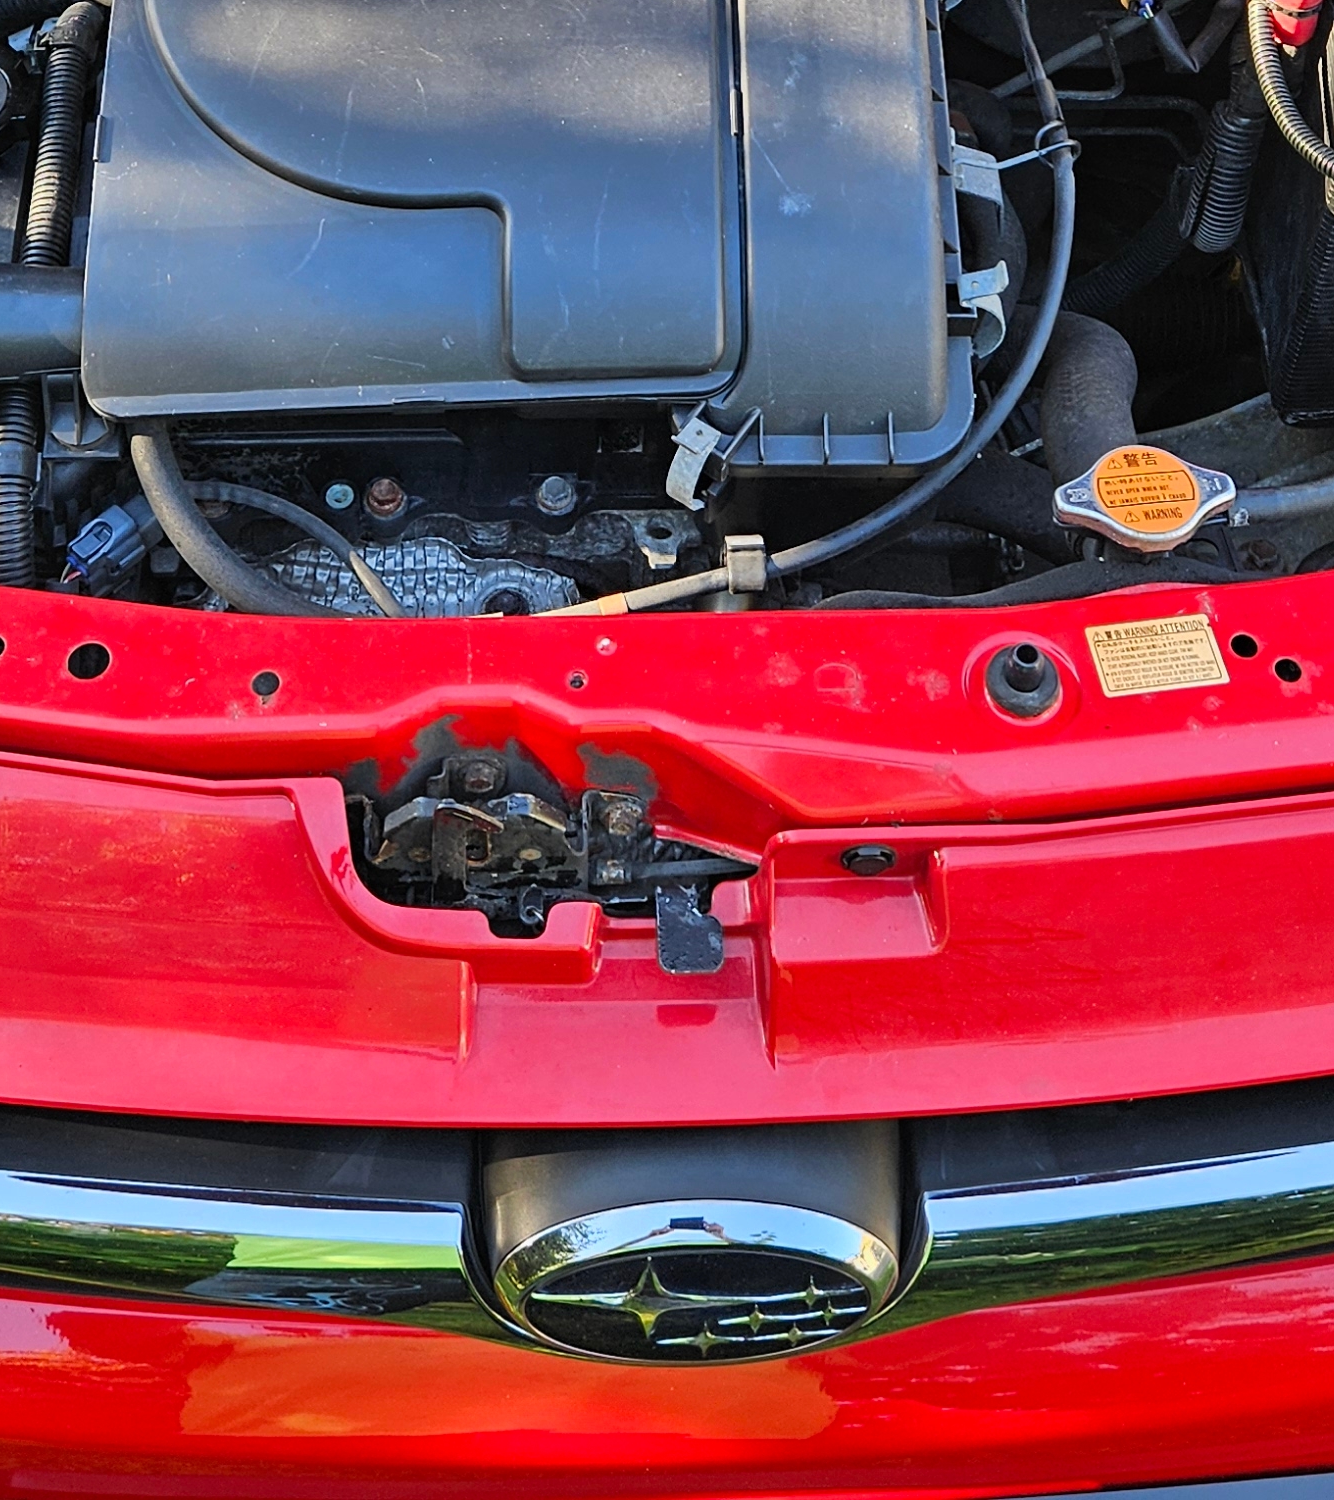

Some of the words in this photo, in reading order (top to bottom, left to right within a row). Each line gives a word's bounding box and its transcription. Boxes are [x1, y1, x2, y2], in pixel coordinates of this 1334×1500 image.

[1122, 452, 1158, 468] 警告
[1126, 487, 1141, 495] OPEN
[1142, 507, 1184, 521] WARNING
[1122, 624, 1158, 638] WARNING
[1160, 619, 1205, 634] ATTENTION
